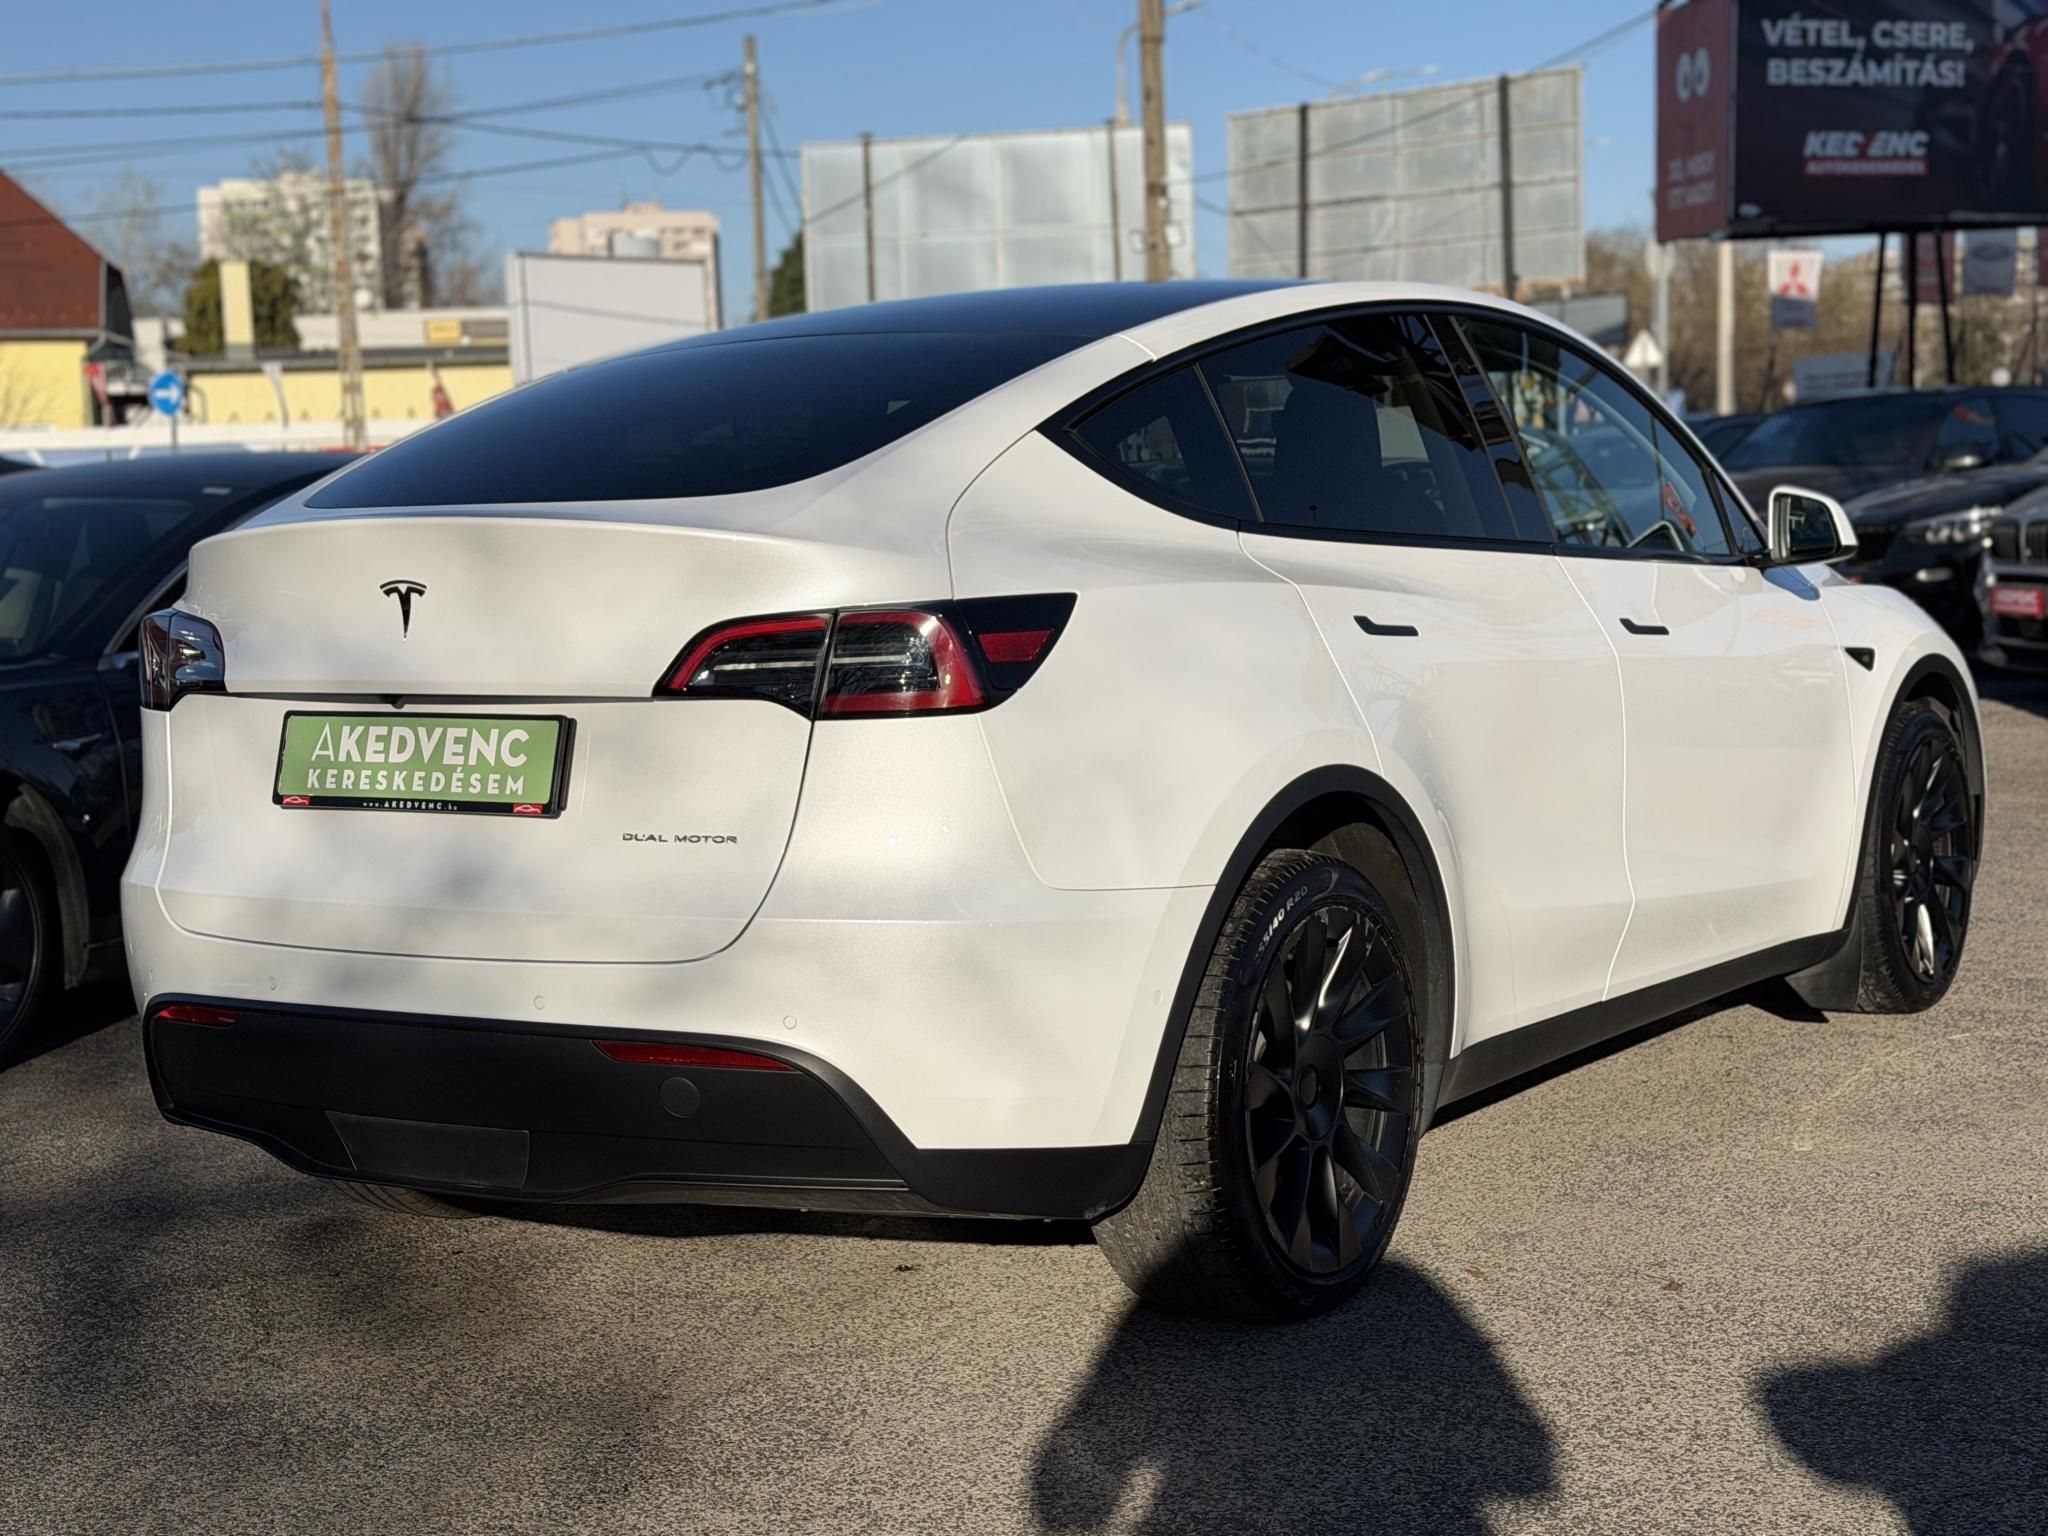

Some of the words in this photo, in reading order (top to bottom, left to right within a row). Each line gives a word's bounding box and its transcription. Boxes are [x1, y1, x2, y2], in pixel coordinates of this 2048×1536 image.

[1761, 13, 1866, 50] VÉTEL,
[1872, 22, 1974, 53] CSERE,
[306, 767, 525, 795] KERESKEDÉSEM
[622, 832, 668, 843] DUAL
[674, 834, 738, 844] MOTOR
